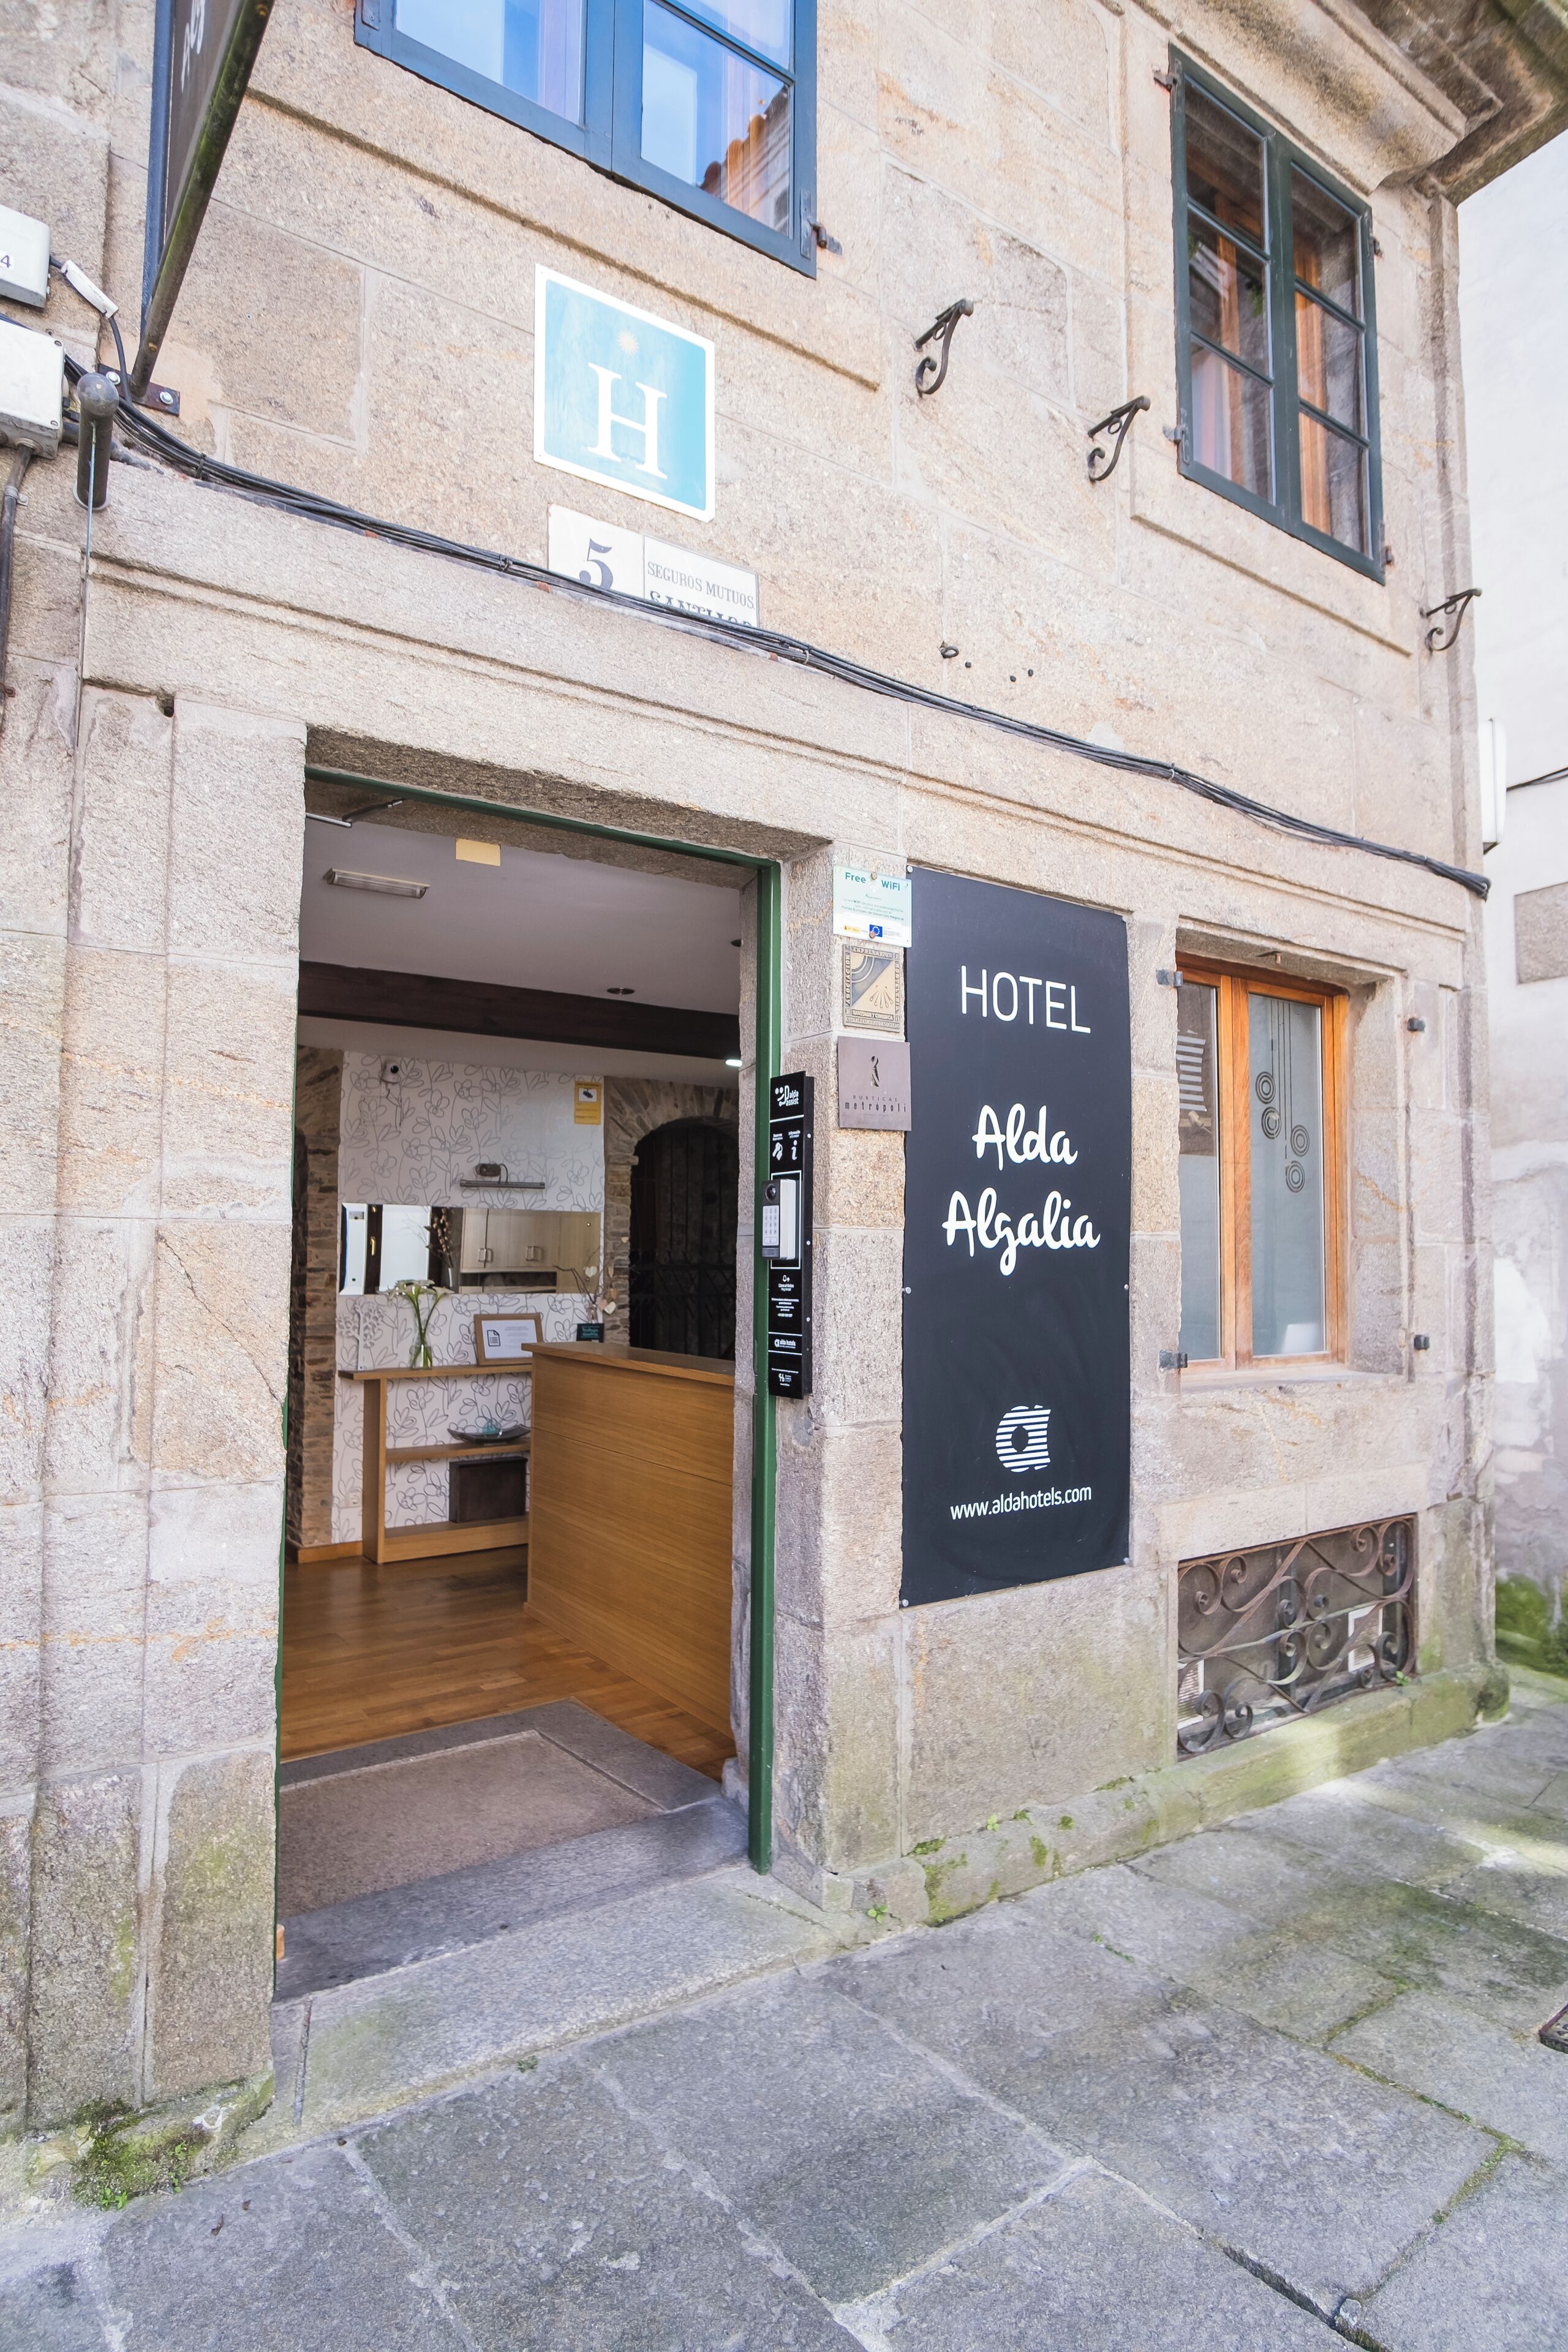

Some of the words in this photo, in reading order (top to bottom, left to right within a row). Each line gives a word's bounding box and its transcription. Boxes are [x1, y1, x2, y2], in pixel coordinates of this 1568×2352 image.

[587, 362, 668, 480] H
[579, 538, 613, 590] 5
[647, 561, 703, 592] SEGUROS
[845, 872, 867, 883] Free
[961, 965, 1091, 1034] HOTEL
[786, 1098, 799, 1106] assist
[971, 1103, 1078, 1171] Alda
[941, 1187, 1101, 1276] Algalia
[949, 1486, 1091, 1520] www.aldahotels.com
